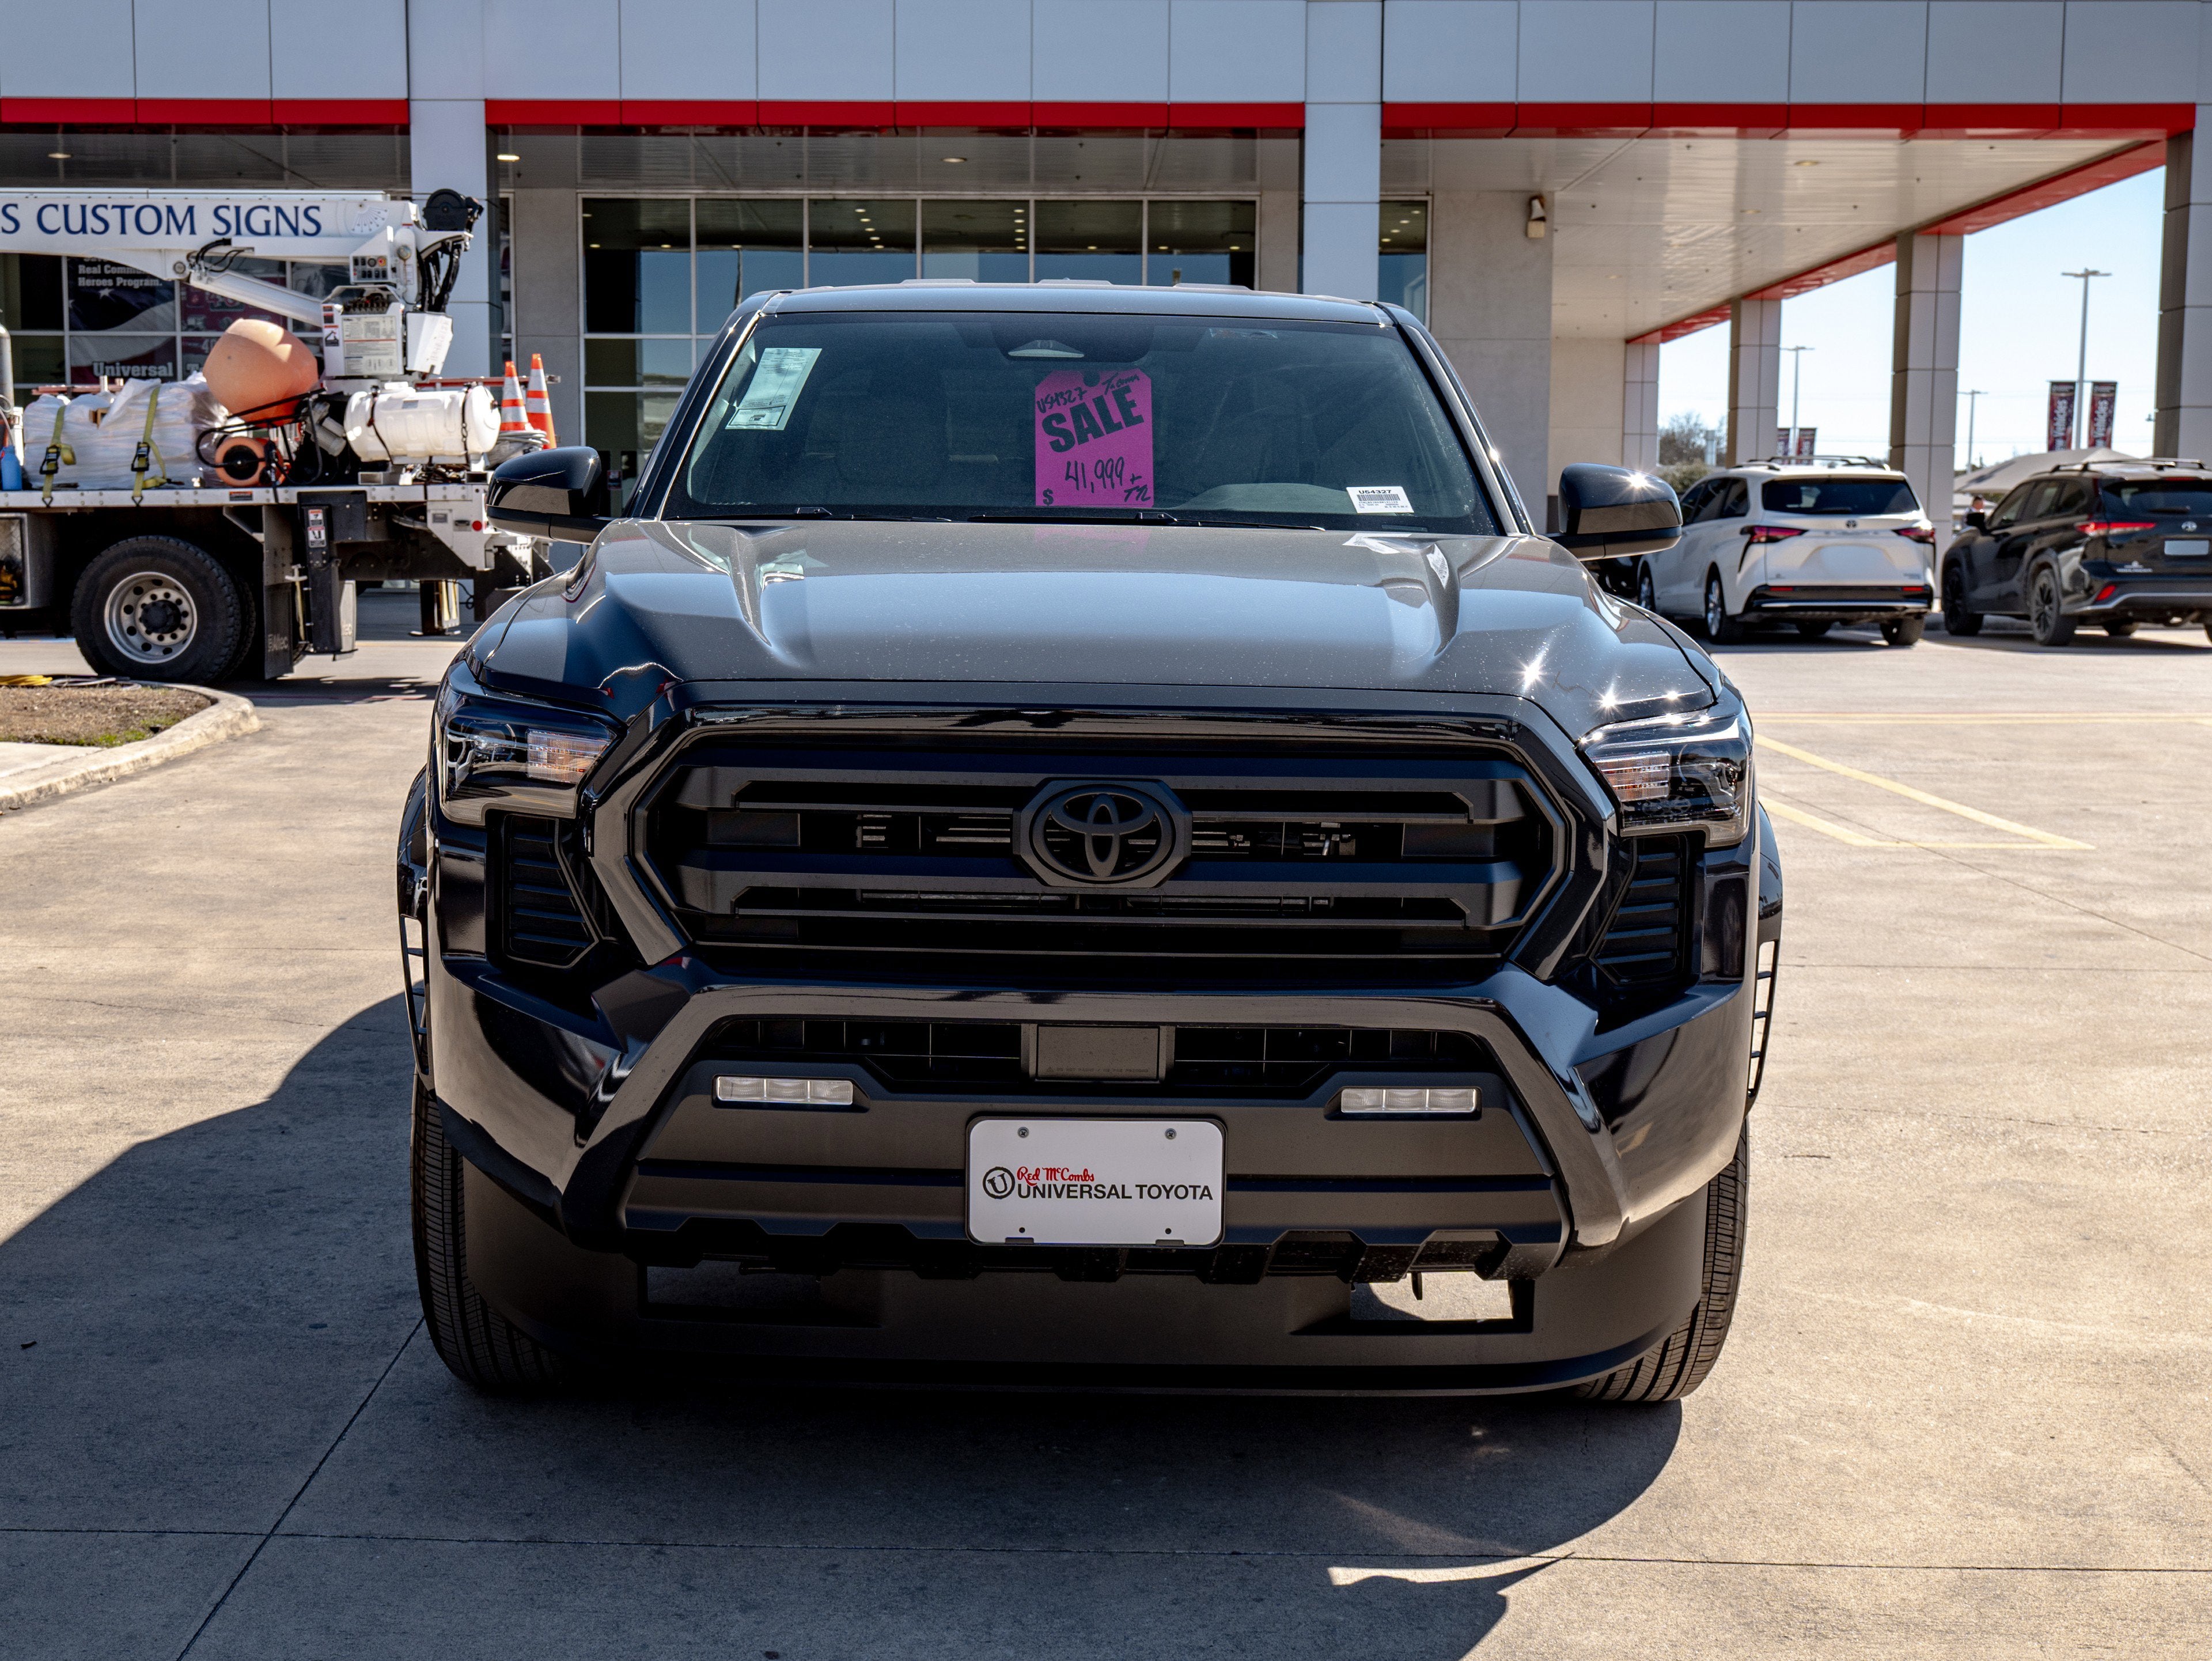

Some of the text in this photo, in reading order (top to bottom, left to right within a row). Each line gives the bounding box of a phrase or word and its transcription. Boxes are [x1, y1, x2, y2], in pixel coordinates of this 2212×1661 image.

[37, 203, 196, 235] CUSTOM
[213, 205, 321, 236] SIGNS
[78, 264, 101, 274] Real
[78, 277, 162, 289] Heroes Program.
[93, 361, 173, 377] Universal
[1041, 385, 1145, 453] SALE
[2052, 398, 2069, 438] Vehicles
[2093, 399, 2109, 438] Vehicles
[1043, 488, 1054, 506] $
[1065, 456, 1124, 494] 41,999
[1017, 1166, 1094, 1186] Red McCombs
[1017, 1183, 1213, 1200] UNIVERSAL TOYOTA
